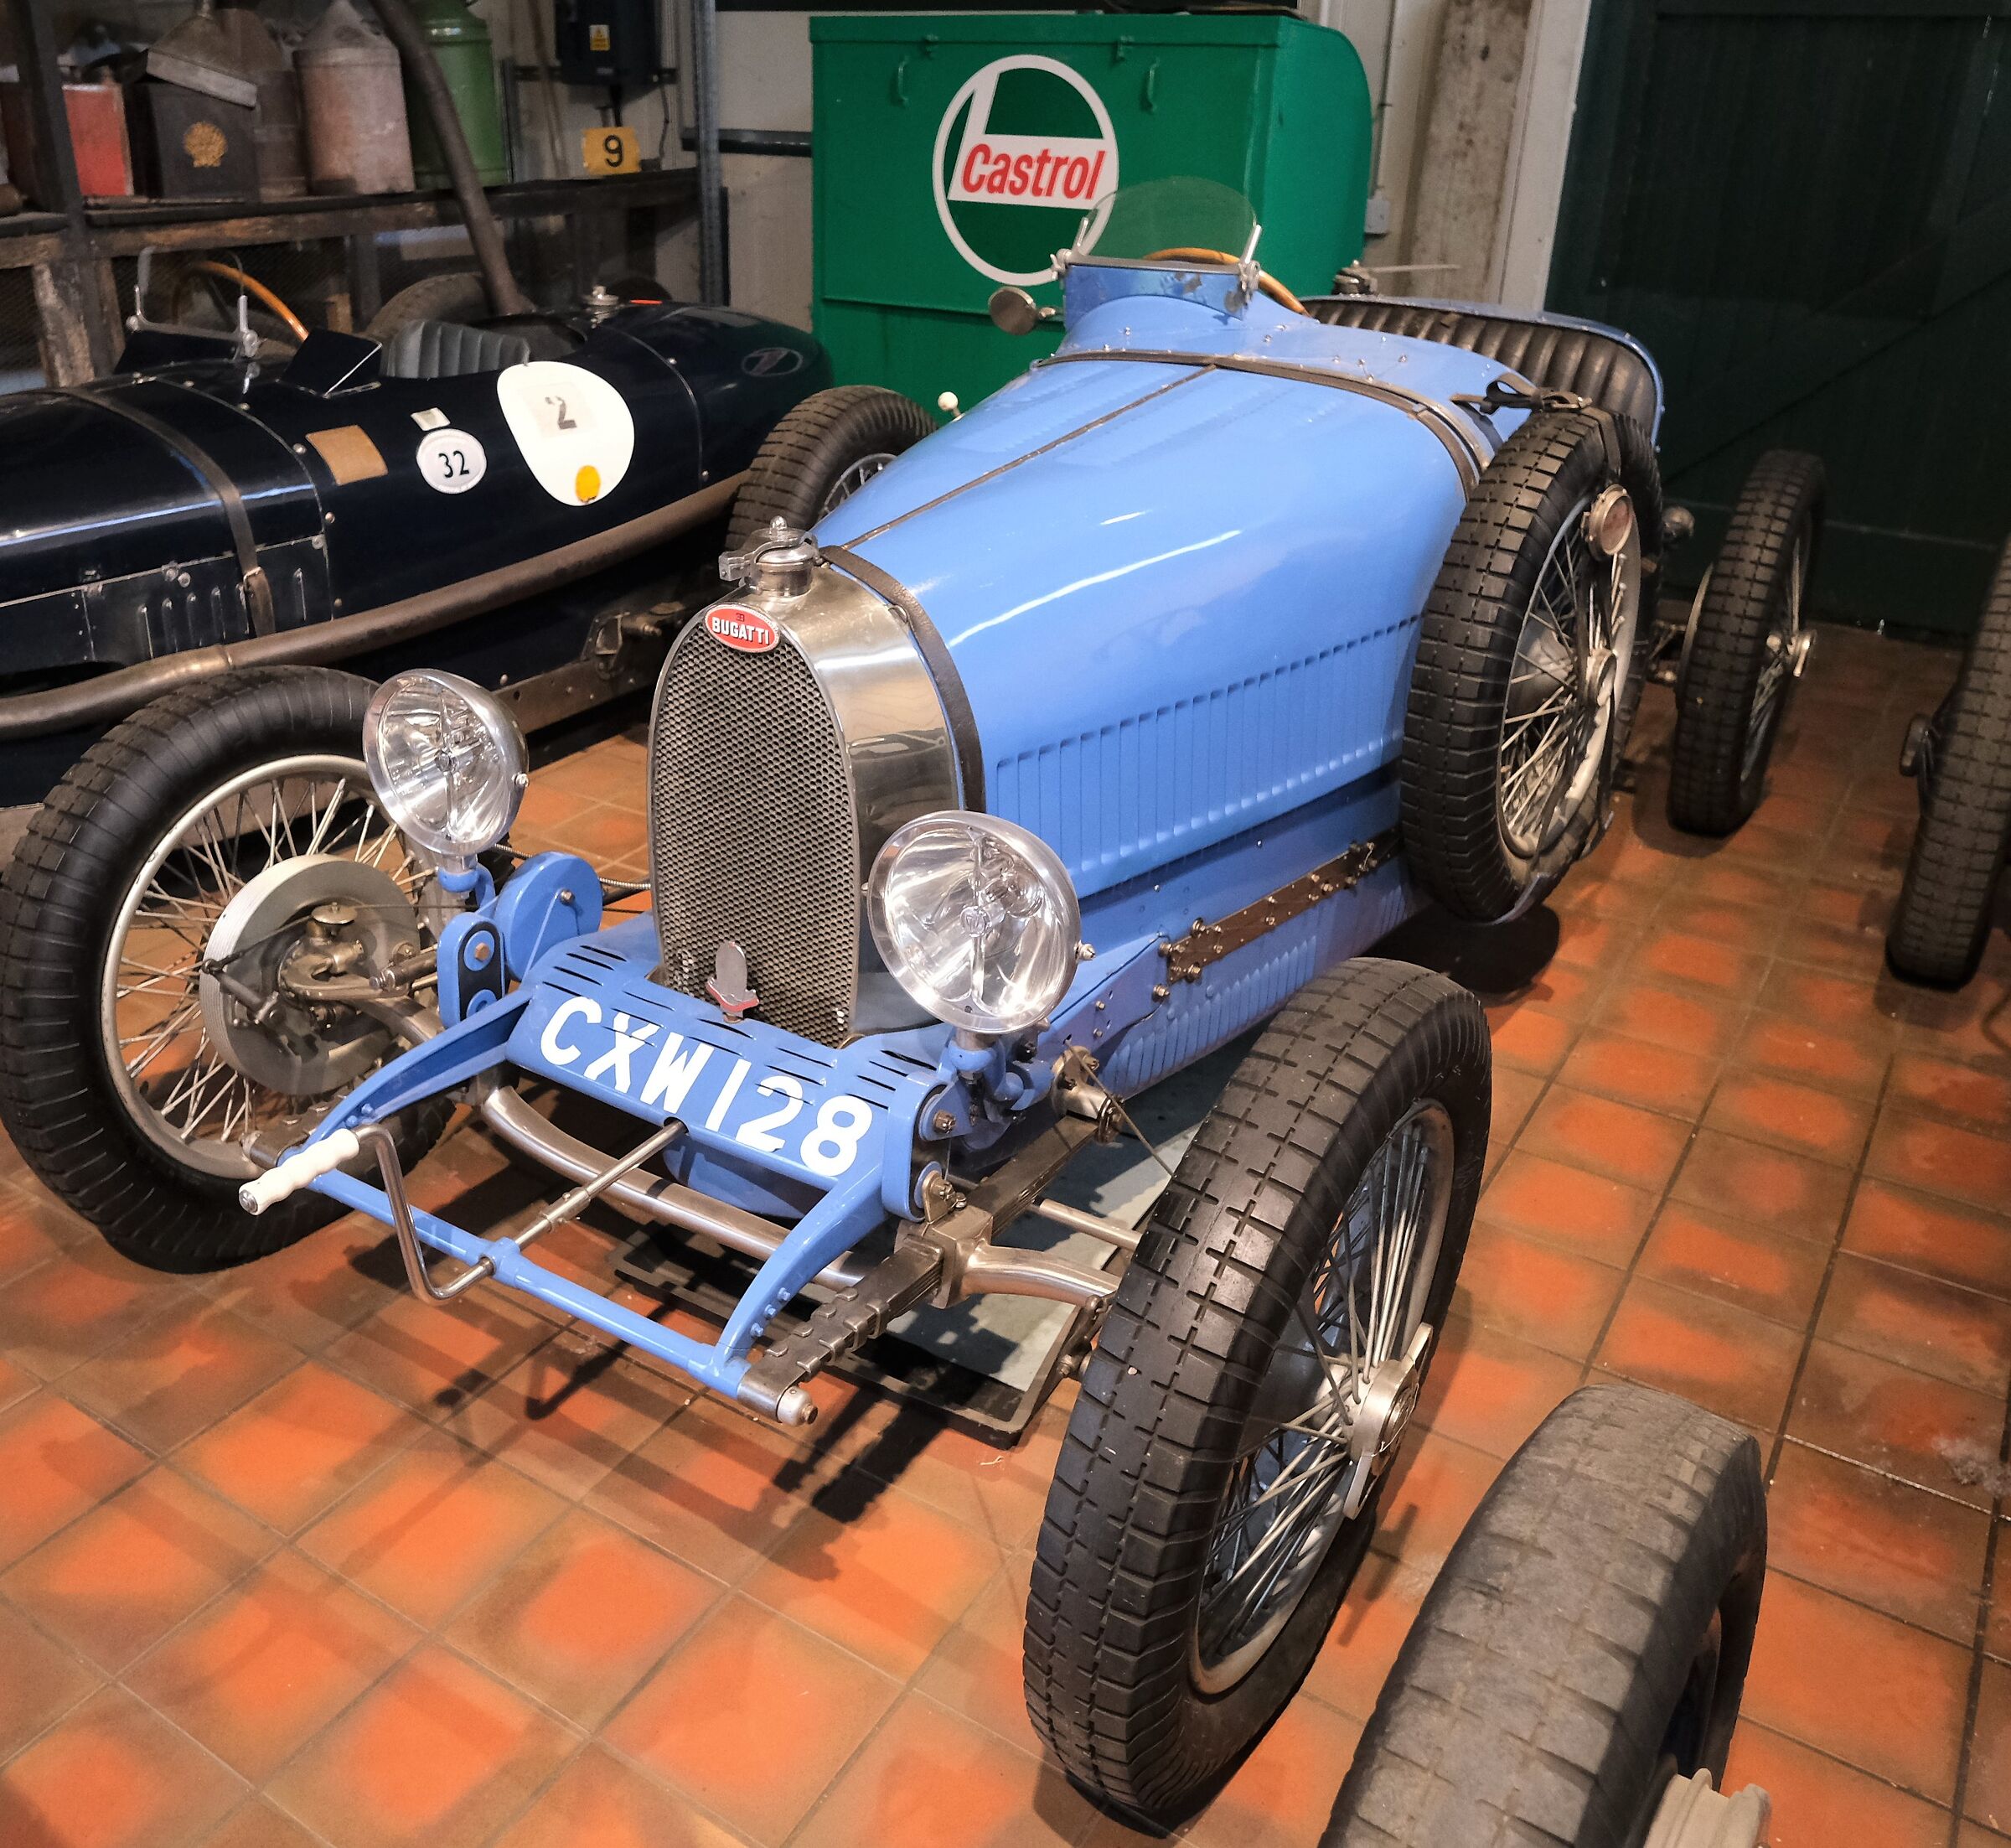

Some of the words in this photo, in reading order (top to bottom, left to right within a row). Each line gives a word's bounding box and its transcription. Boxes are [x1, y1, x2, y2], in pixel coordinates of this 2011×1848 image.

[604, 135, 623, 168] 9
[963, 143, 1106, 199] Castrol
[438, 450, 470, 478] 32
[711, 616, 770, 645] BUGATTI
